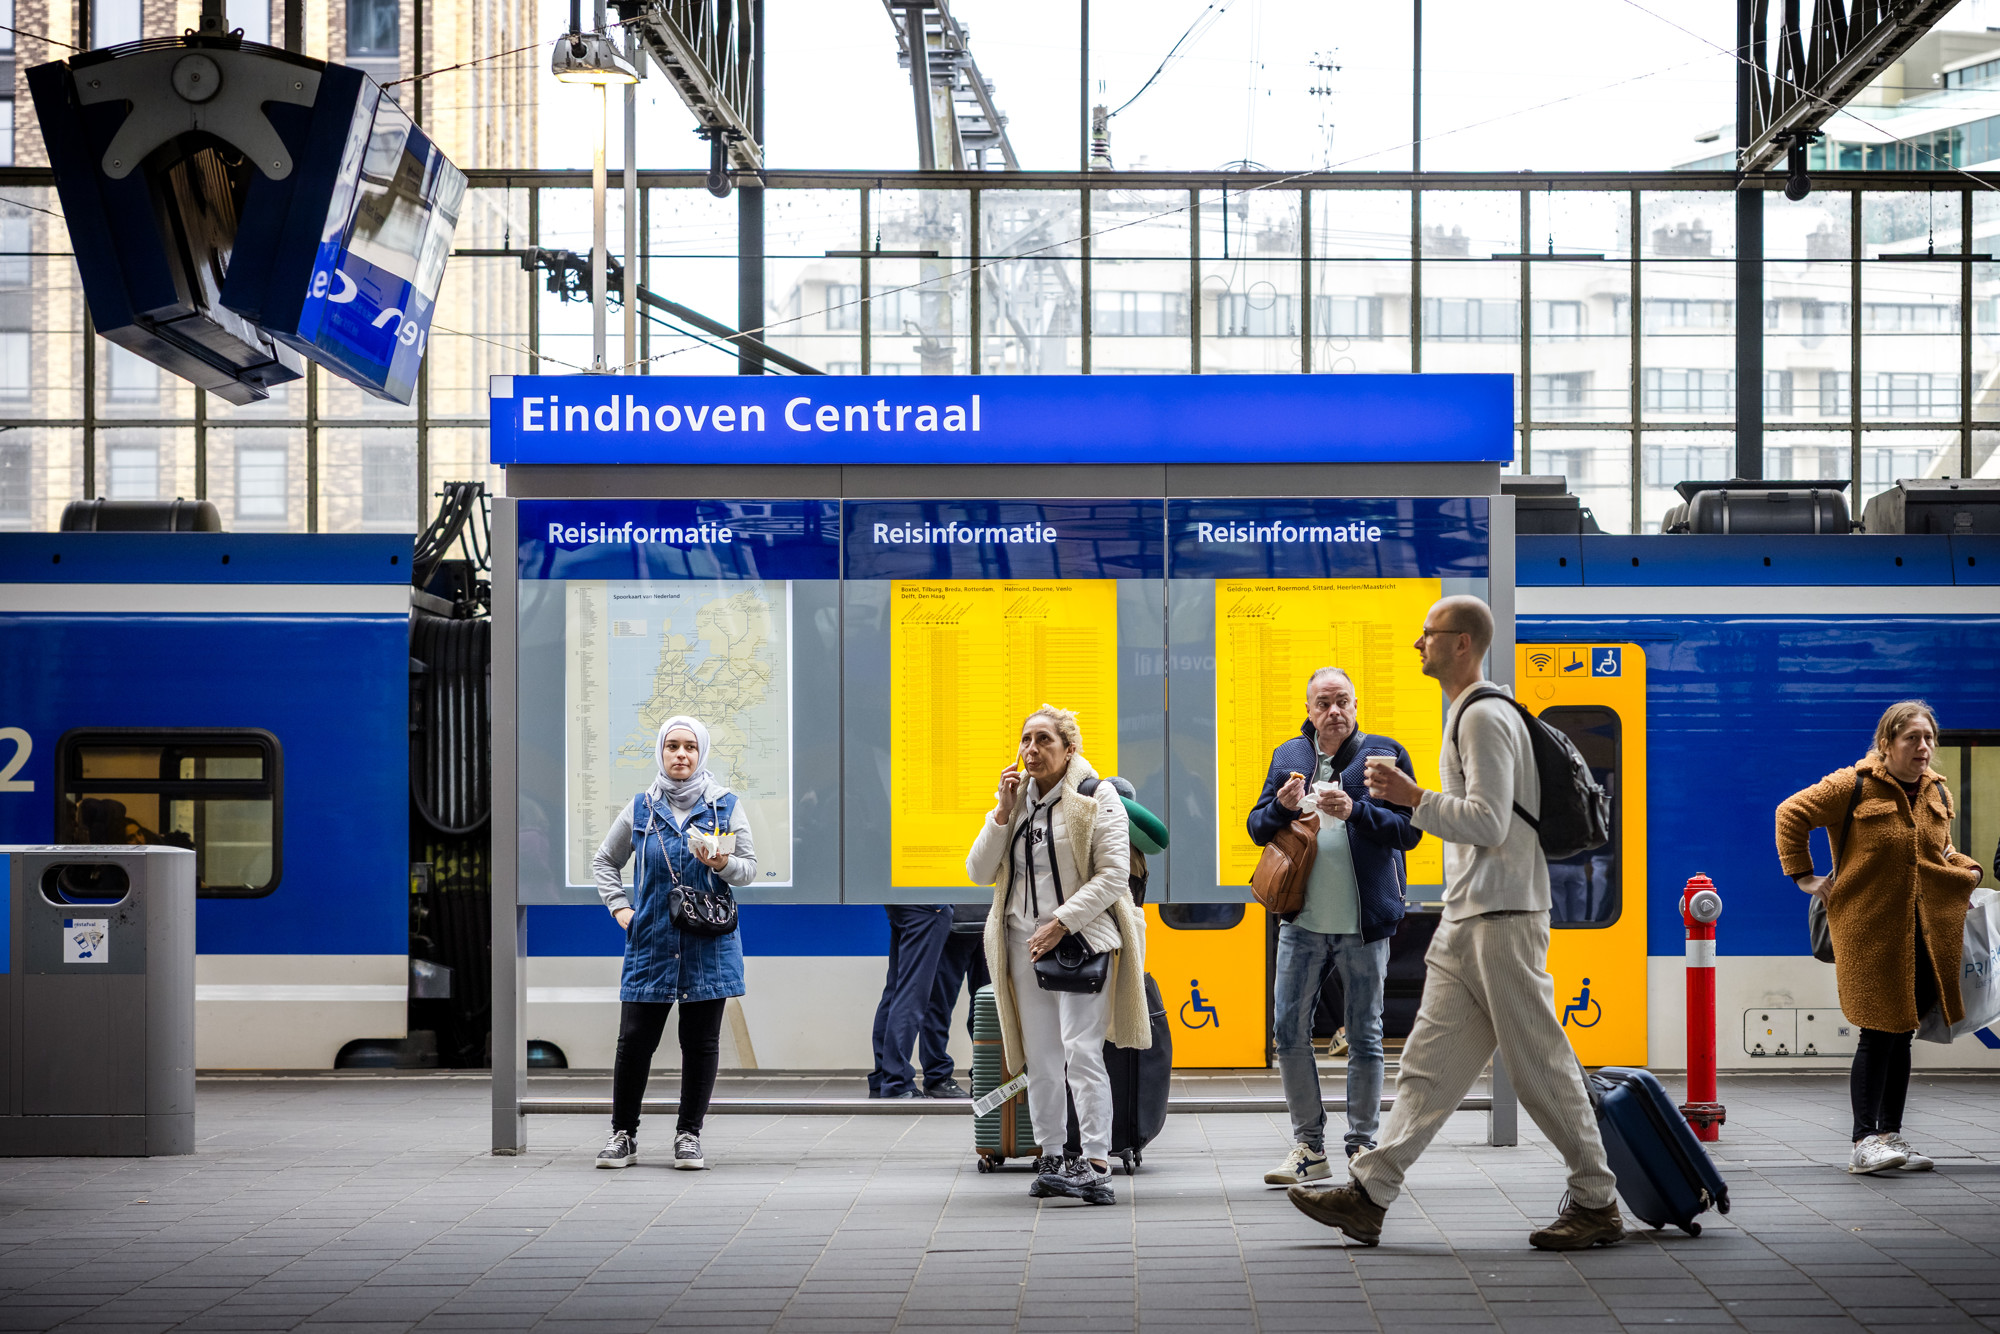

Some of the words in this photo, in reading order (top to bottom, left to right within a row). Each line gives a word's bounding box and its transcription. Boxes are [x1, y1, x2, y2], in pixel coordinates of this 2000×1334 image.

[522, 394, 766, 433] Eindhoven
[783, 394, 982, 433] Centraal
[547, 521, 733, 545] Reisinformatie
[872, 521, 1057, 544] Reisinformatie
[1198, 520, 1382, 543] Reisinformatie
[0, 726, 35, 792] 2
